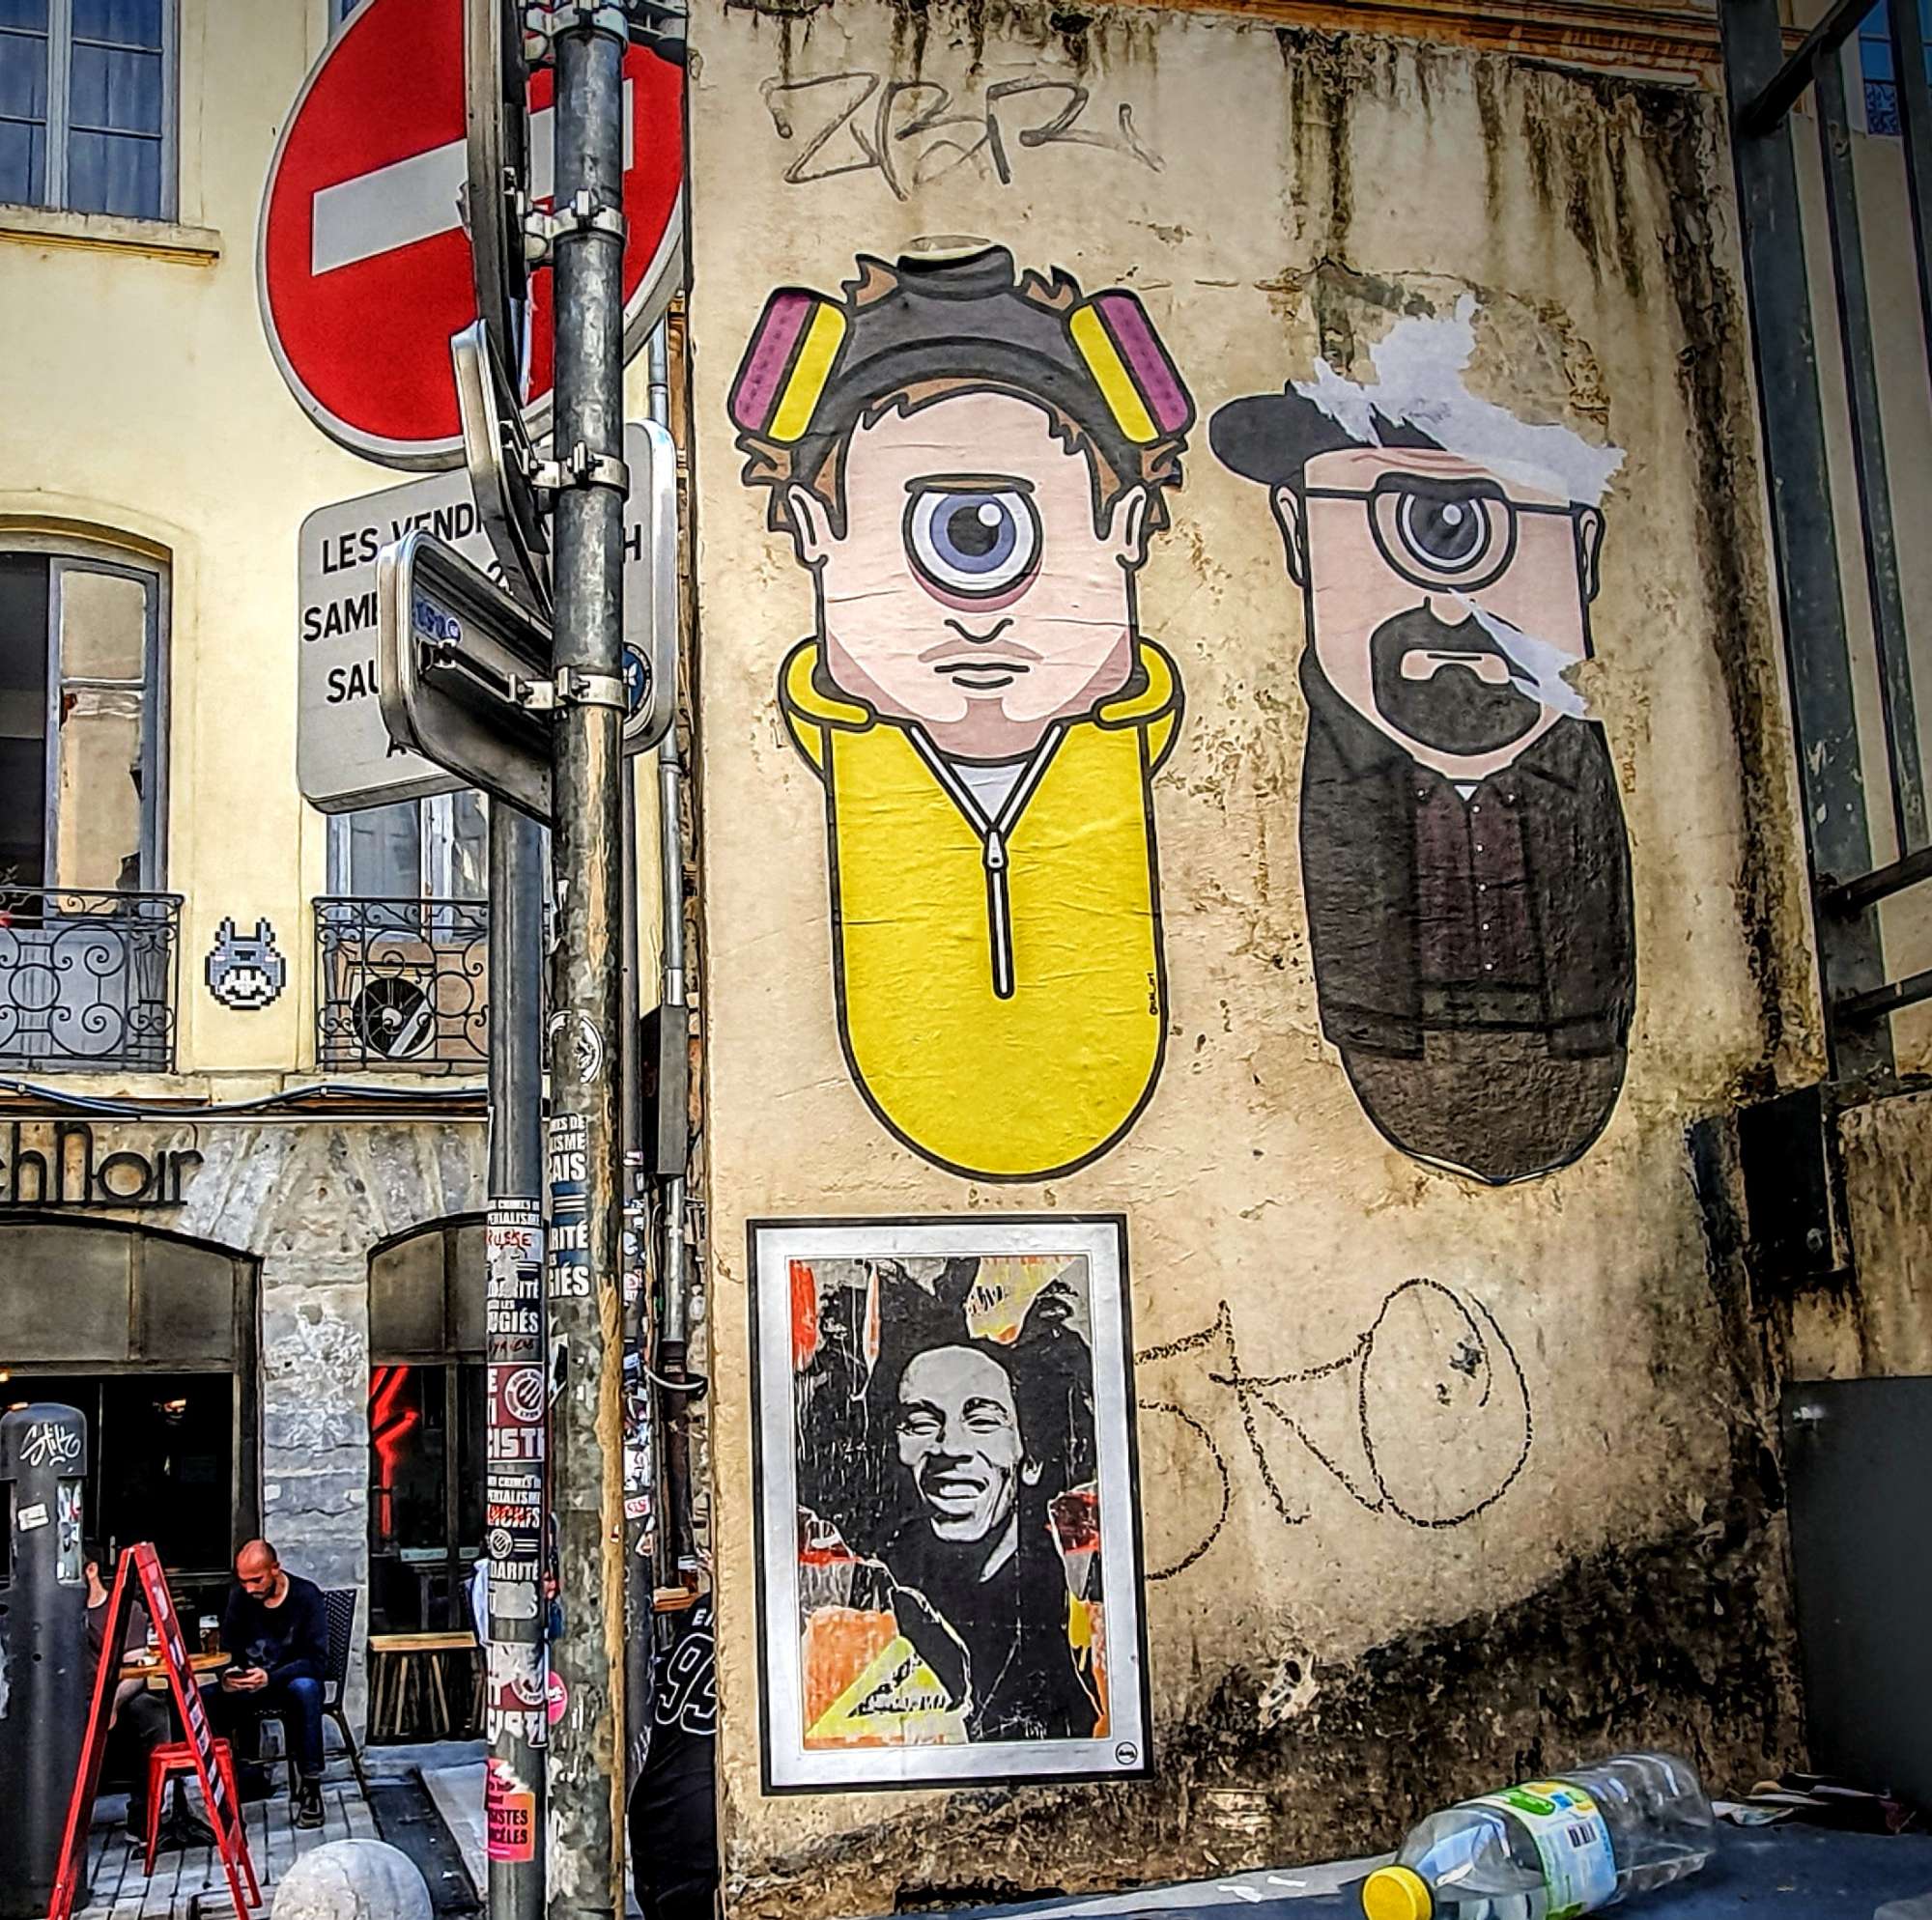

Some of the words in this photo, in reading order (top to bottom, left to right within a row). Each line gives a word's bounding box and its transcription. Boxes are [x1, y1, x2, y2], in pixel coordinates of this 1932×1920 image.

[322, 527, 379, 574] LES
[390, 501, 482, 543] VEND
[302, 591, 378, 642] SAM
[549, 1152, 586, 1182] AIS
